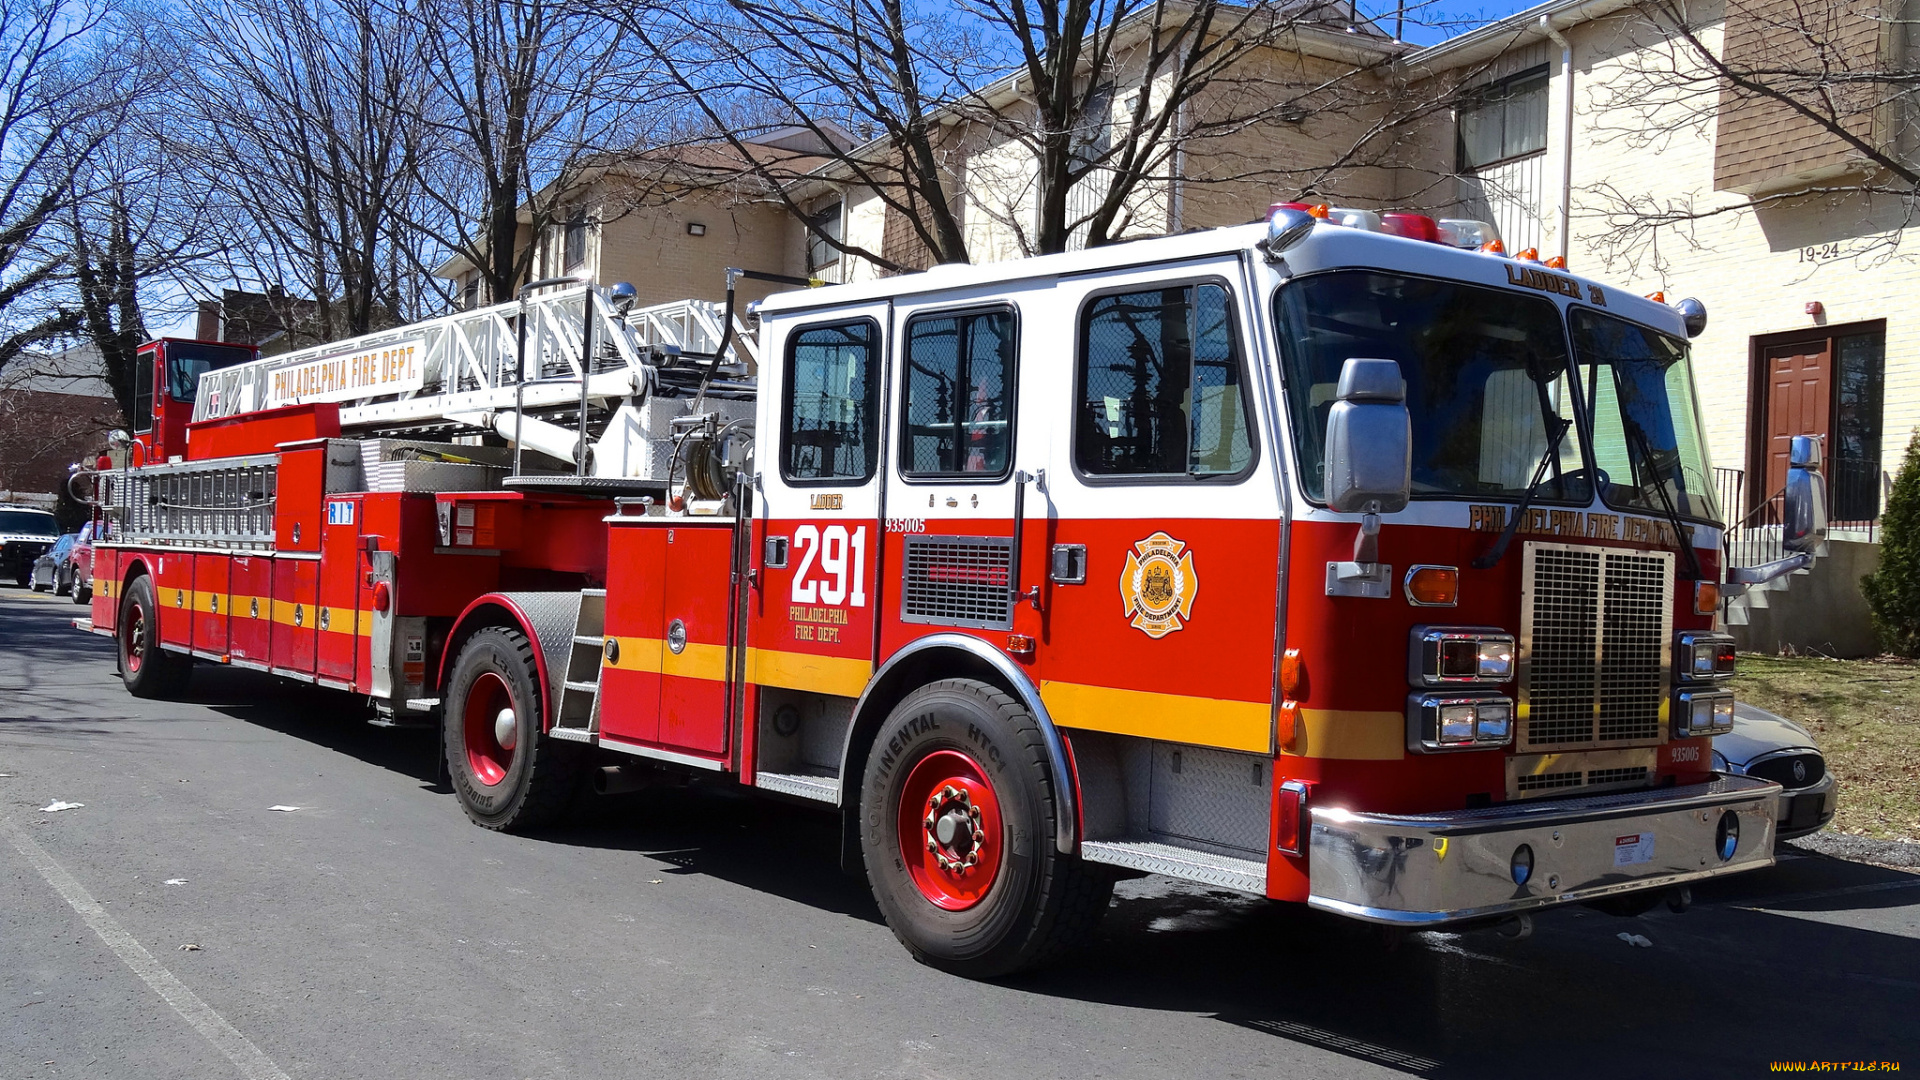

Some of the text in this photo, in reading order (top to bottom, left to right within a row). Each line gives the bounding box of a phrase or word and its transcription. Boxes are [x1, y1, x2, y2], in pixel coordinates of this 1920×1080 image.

[1799, 242, 1840, 263] 19-24
[1503, 263, 1583, 300] LADDER
[274, 346, 416, 400] PHILADELPHIA FIRE DEPT.
[810, 493, 844, 510] LADDER
[885, 518, 926, 533] 935005
[1586, 512, 1619, 540] FIRE
[791, 524, 866, 607] 291
[1138, 548, 1180, 567] PHILADELPHIA
[789, 605, 848, 625] PHILADELPHIA
[1133, 597, 1181, 621] FIRE DEPARTMENT
[794, 624, 841, 643] FIRE DEPT.
[1671, 746, 1700, 763] 935005
[868, 712, 940, 847] CONTINENTAL
